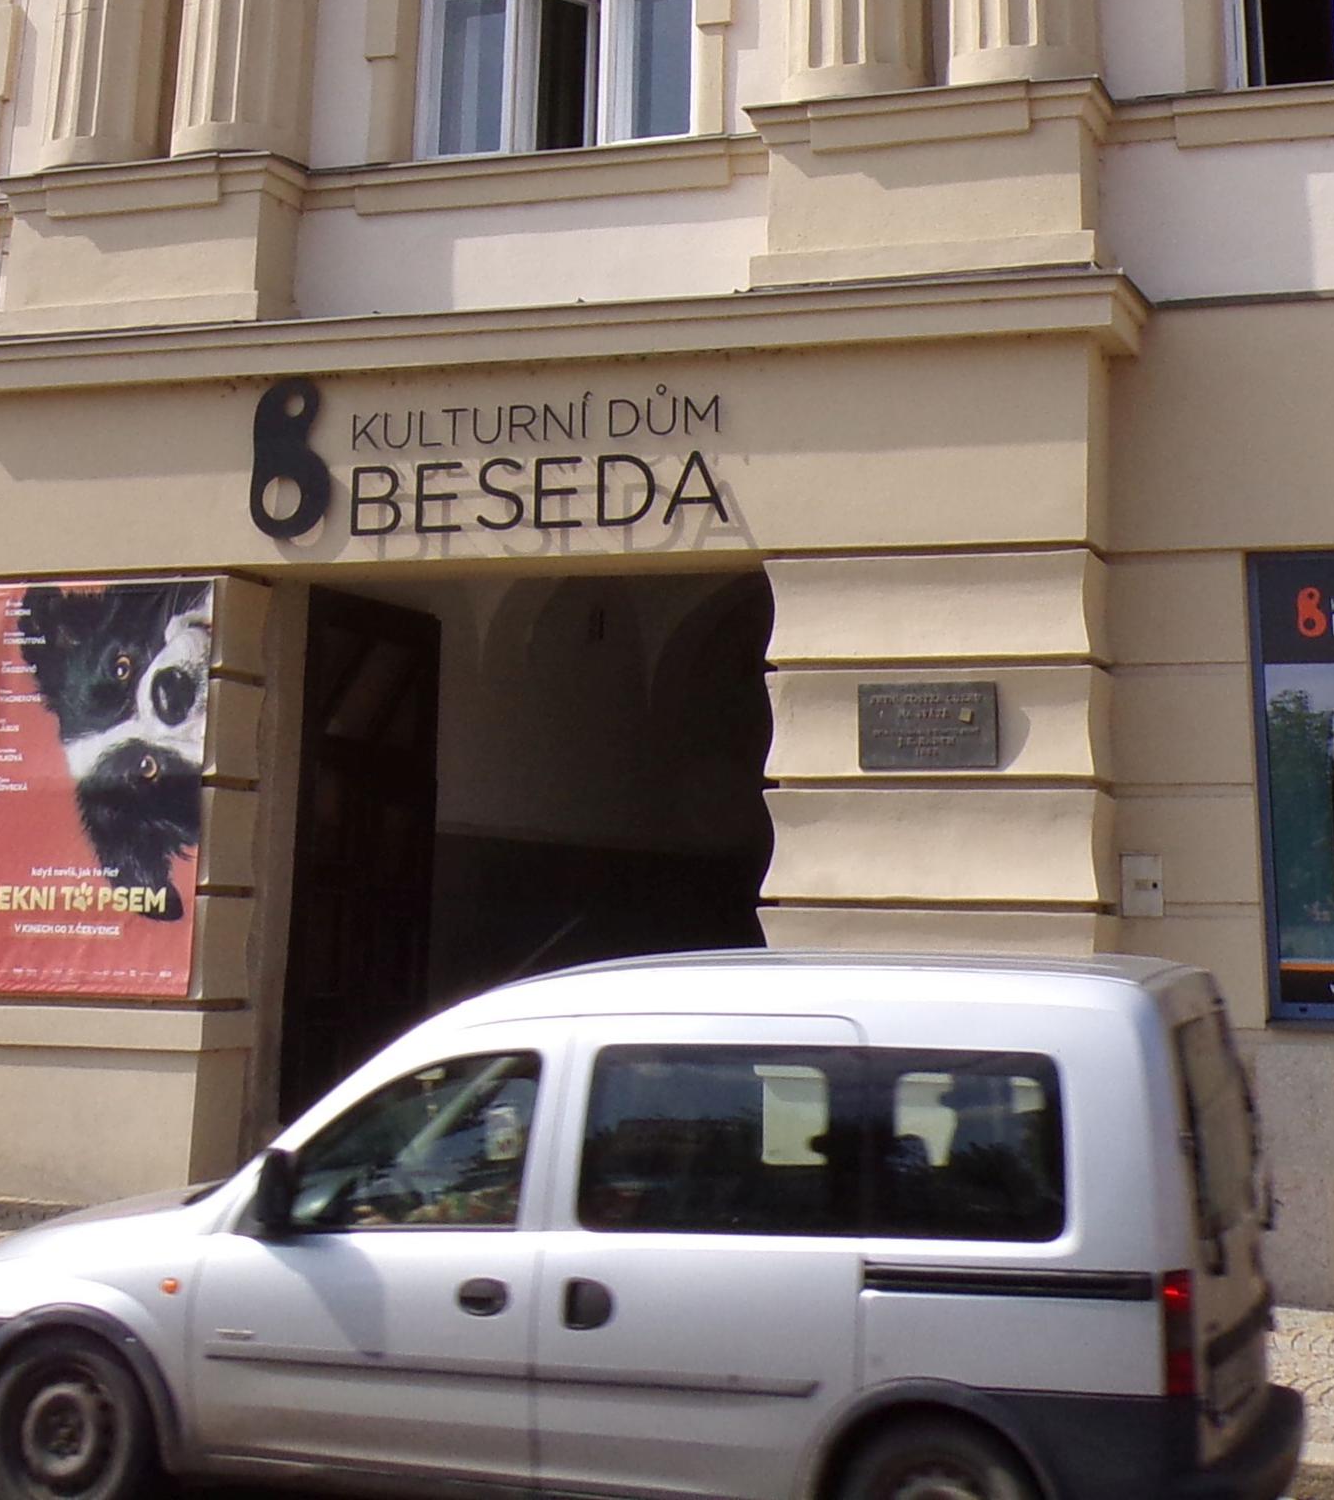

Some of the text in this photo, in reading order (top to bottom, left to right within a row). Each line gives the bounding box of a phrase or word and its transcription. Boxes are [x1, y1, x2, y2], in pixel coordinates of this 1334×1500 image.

[351, 384, 722, 451] KULTURNÍ DŮM
[350, 450, 729, 537] BESEDA
[97, 886, 167, 913] PSEM
